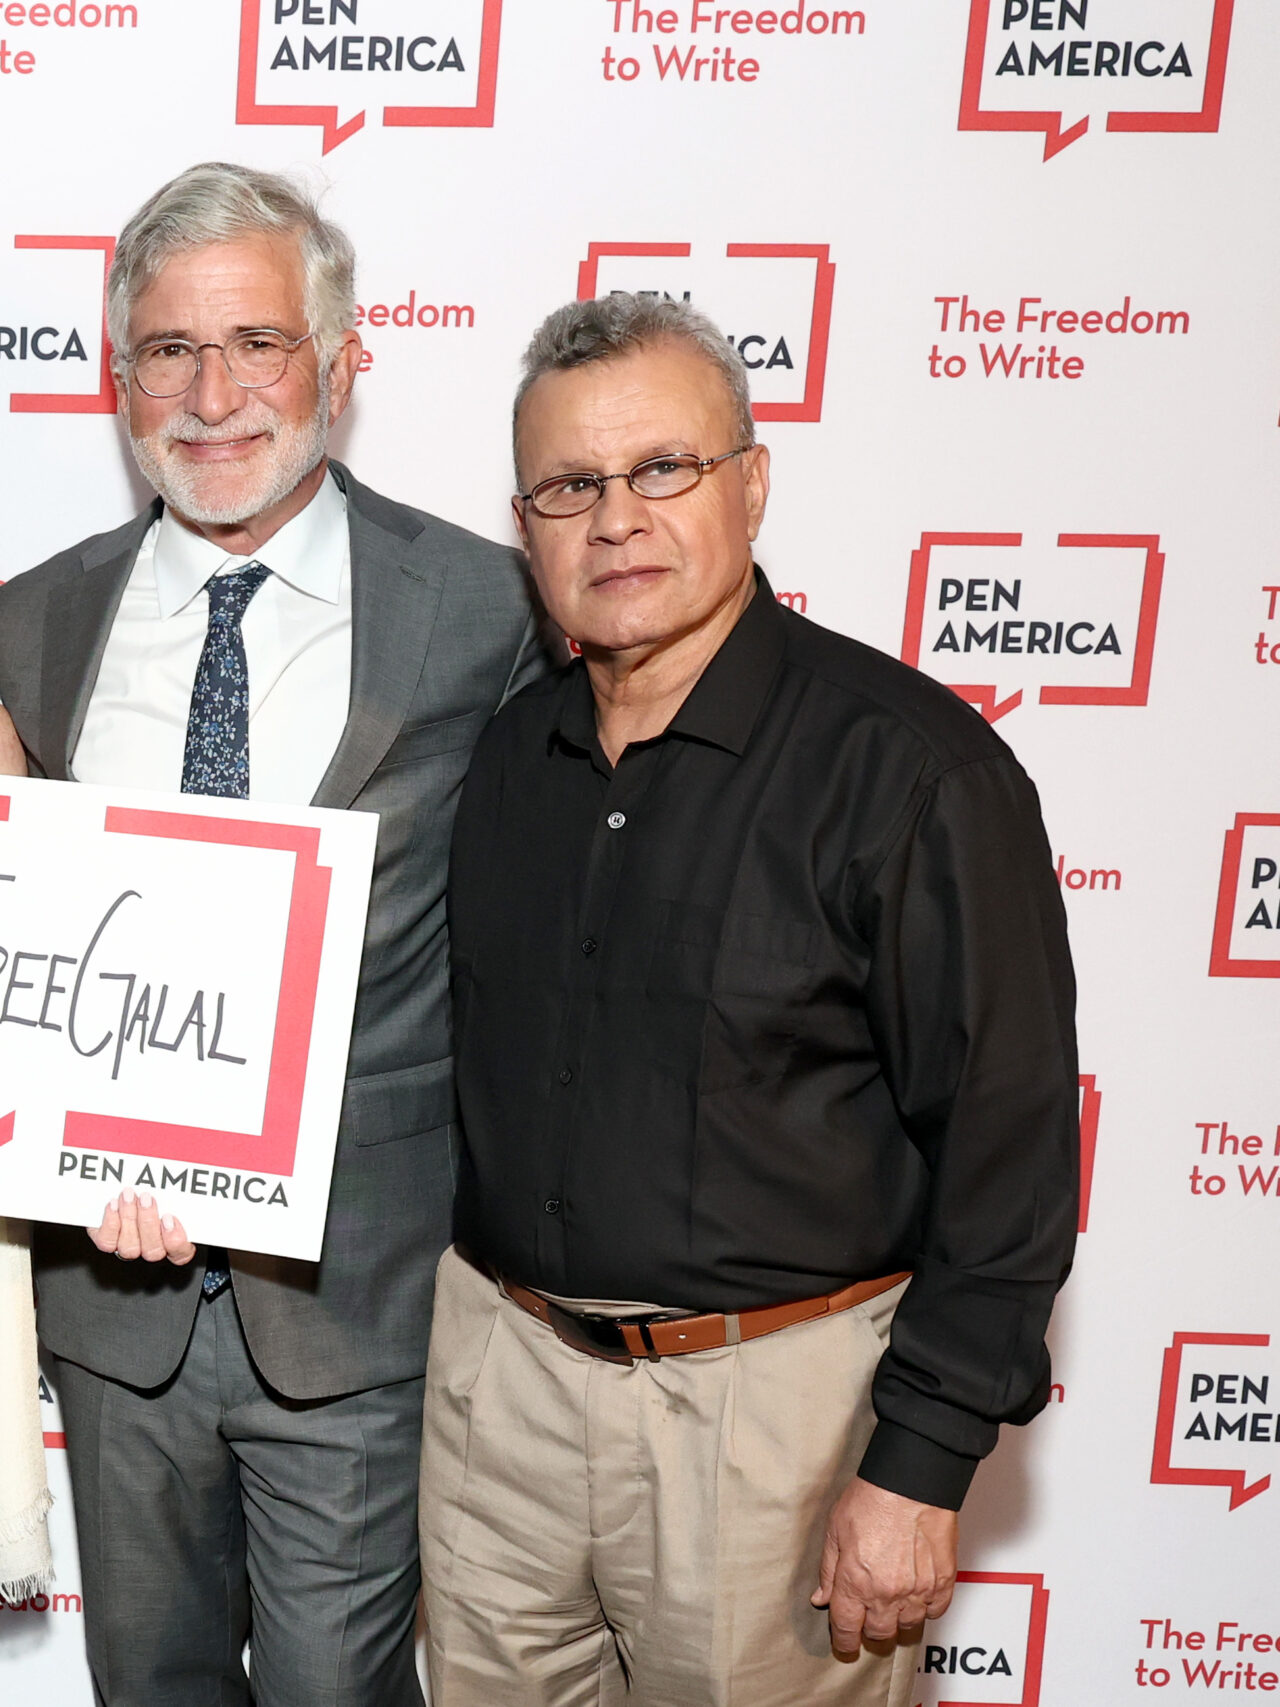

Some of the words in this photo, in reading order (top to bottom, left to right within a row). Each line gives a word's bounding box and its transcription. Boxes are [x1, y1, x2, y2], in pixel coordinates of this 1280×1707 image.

[275, 0, 357, 25] PEN
[608, 0, 678, 33] The
[691, 0, 865, 34] Freedom
[1003, 0, 1088, 30] PEN
[271, 36, 464, 71] AMERICA
[602, 47, 640, 80] to
[654, 45, 760, 82] Write
[996, 41, 1192, 77] AMERICA
[935, 296, 1005, 333] The
[1018, 296, 1189, 333] Freedom
[929, 345, 966, 378] to
[980, 344, 1084, 379] Write
[939, 579, 1021, 611] PEN
[933, 621, 1121, 654] AMERICA
[1196, 1122, 1263, 1155] The
[58, 1151, 124, 1182] PEN
[134, 1163, 289, 1207] AMERICA
[1190, 1166, 1226, 1195] to
[1190, 1374, 1269, 1404] PEN
[1141, 1619, 1205, 1650] The
[924, 1645, 1012, 1676] RICA
[1136, 1660, 1170, 1687] to
[1183, 1659, 1279, 1690] Write
